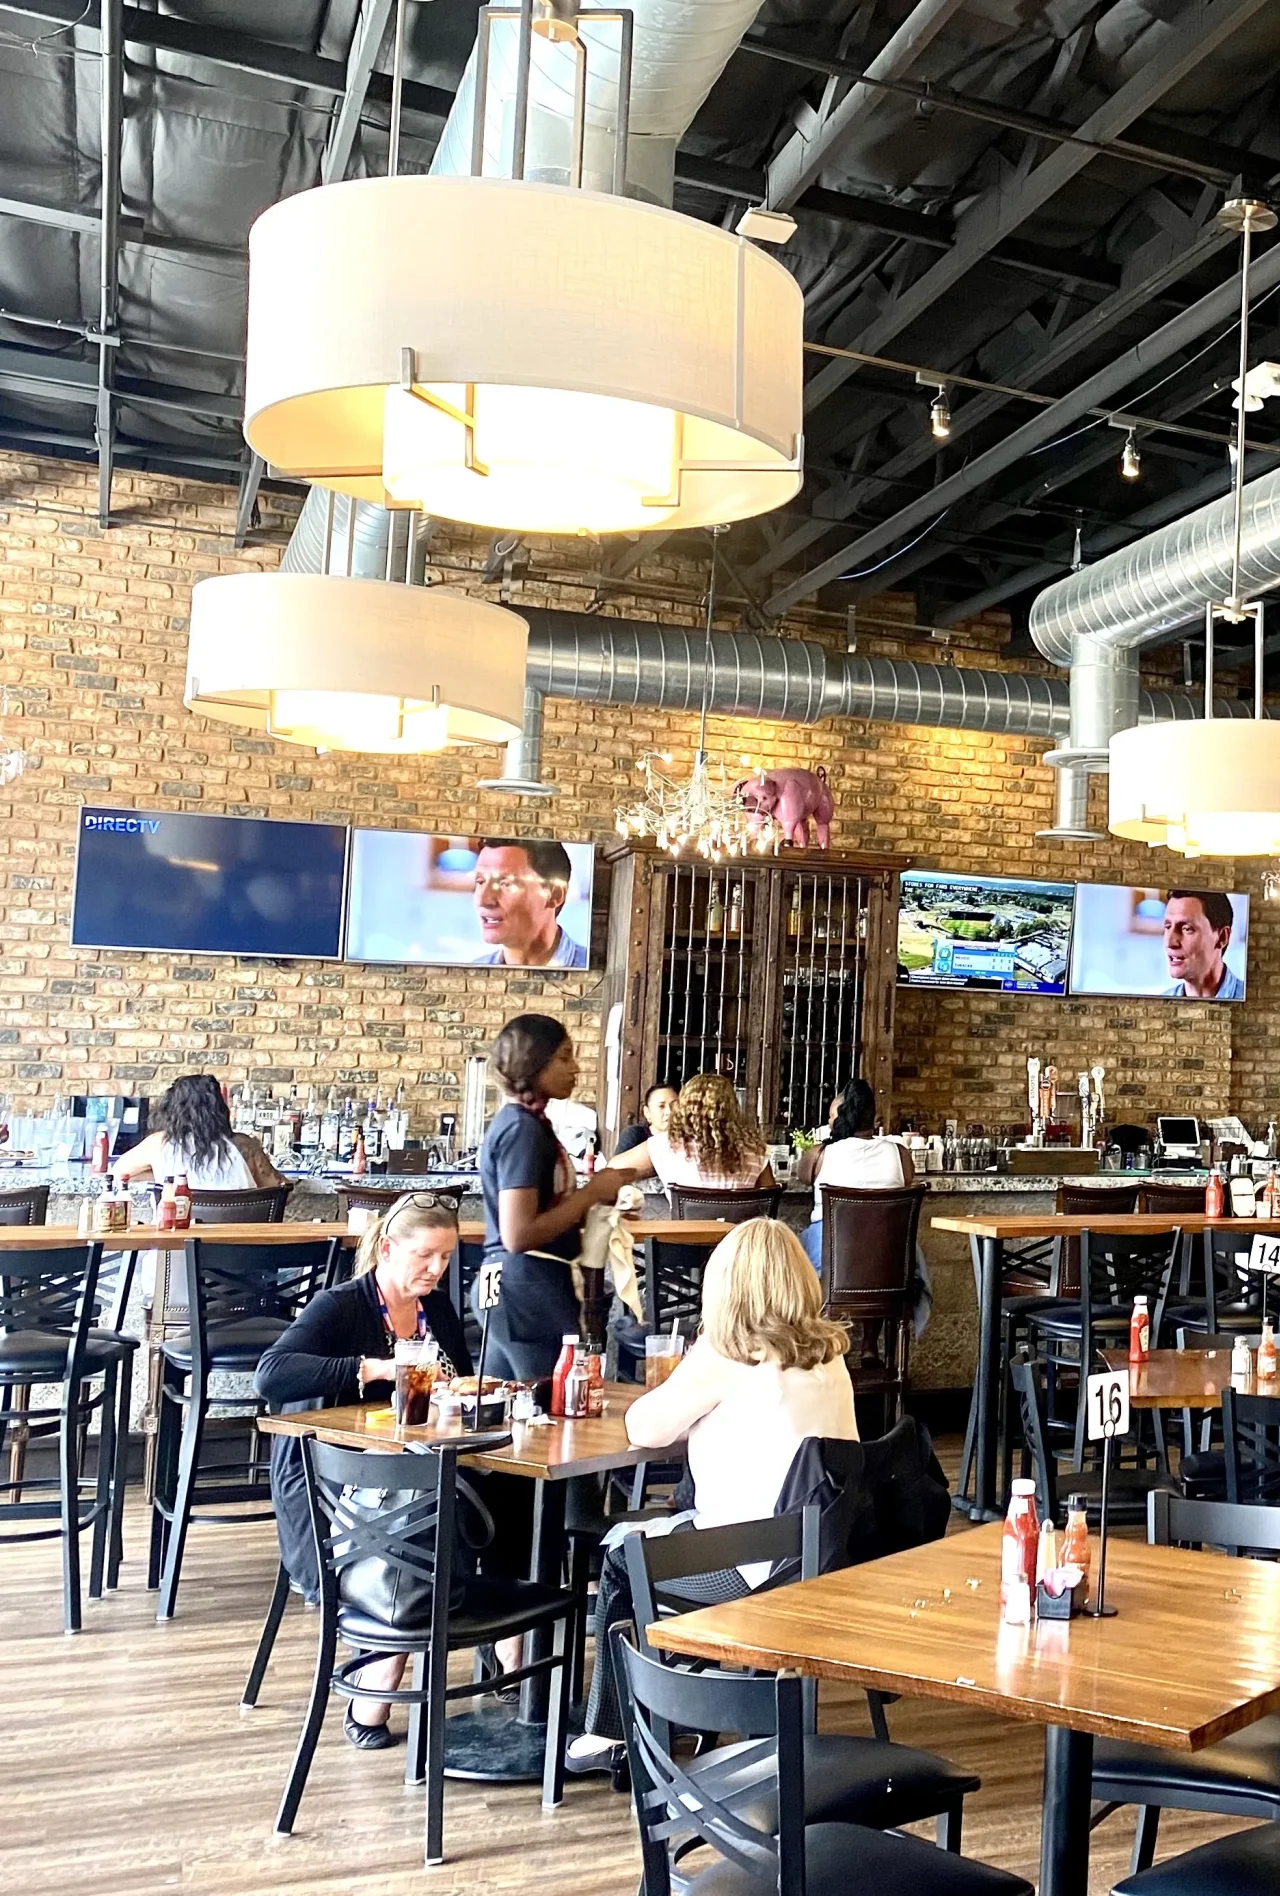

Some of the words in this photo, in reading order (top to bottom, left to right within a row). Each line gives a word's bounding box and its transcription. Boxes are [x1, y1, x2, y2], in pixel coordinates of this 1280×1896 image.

[85, 816, 160, 833] DIRECTV
[1259, 1243, 1280, 1267] 14
[1095, 1382, 1121, 1426] 16
